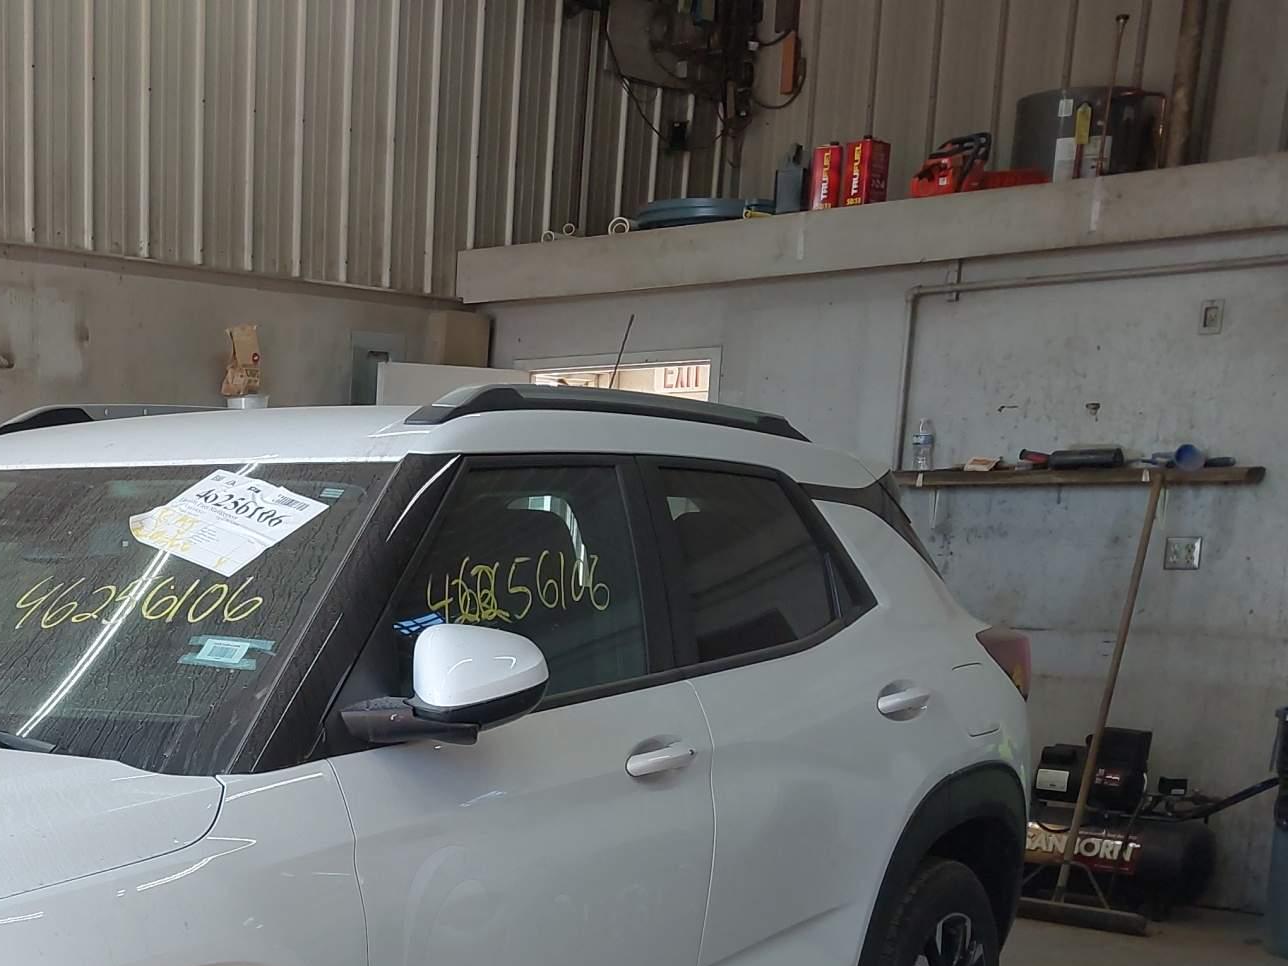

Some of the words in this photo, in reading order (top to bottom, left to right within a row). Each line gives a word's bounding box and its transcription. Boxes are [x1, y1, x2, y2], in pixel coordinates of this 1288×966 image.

[820, 149, 832, 201] TRUFUEL
[850, 143, 862, 196] TRUFUEL
[663, 366, 700, 389] EXIT
[15, 576, 263, 630] 46256106
[1026, 832, 1141, 862] ANORN
